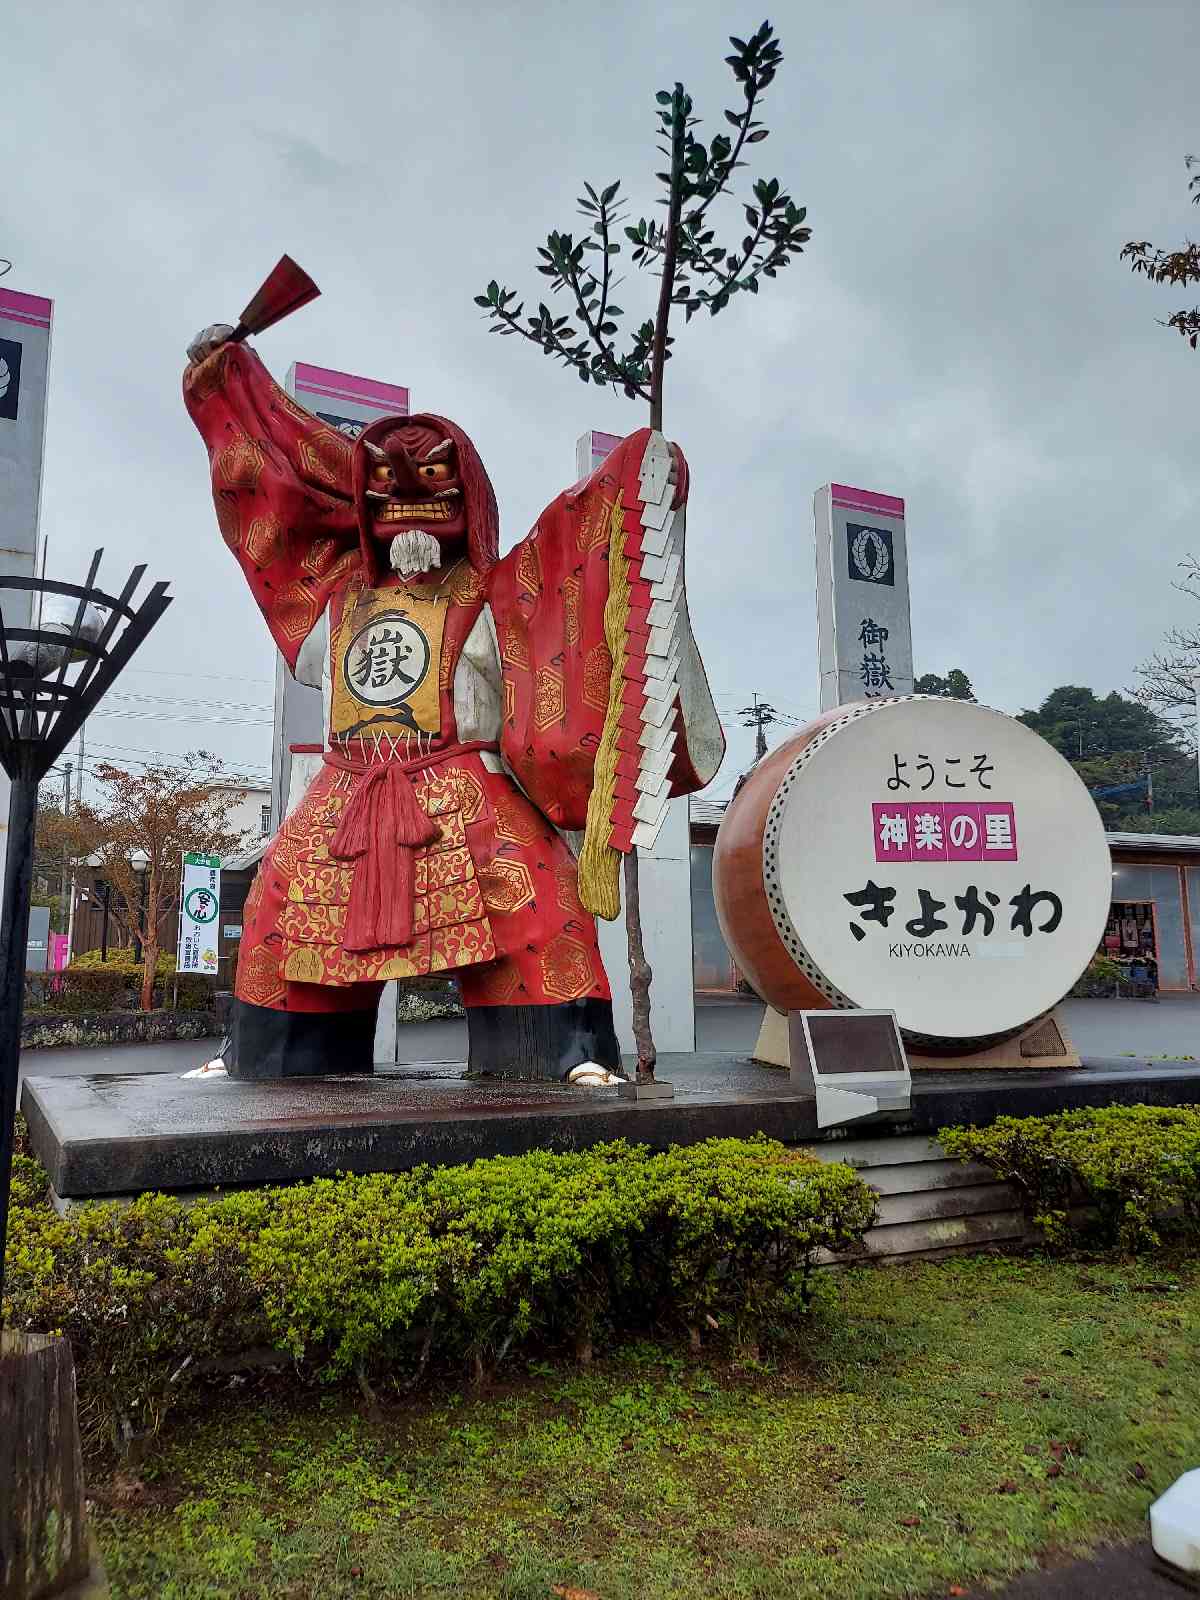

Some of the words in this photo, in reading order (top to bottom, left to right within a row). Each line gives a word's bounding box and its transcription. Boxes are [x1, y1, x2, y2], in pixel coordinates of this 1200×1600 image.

[858, 617, 895, 698] 御嶽
[886, 753, 994, 791] ようこそ
[879, 813, 1015, 851] 神楽の里
[842, 879, 1064, 942] きよかわ
[888, 943, 971, 958] KIYOKAWA
